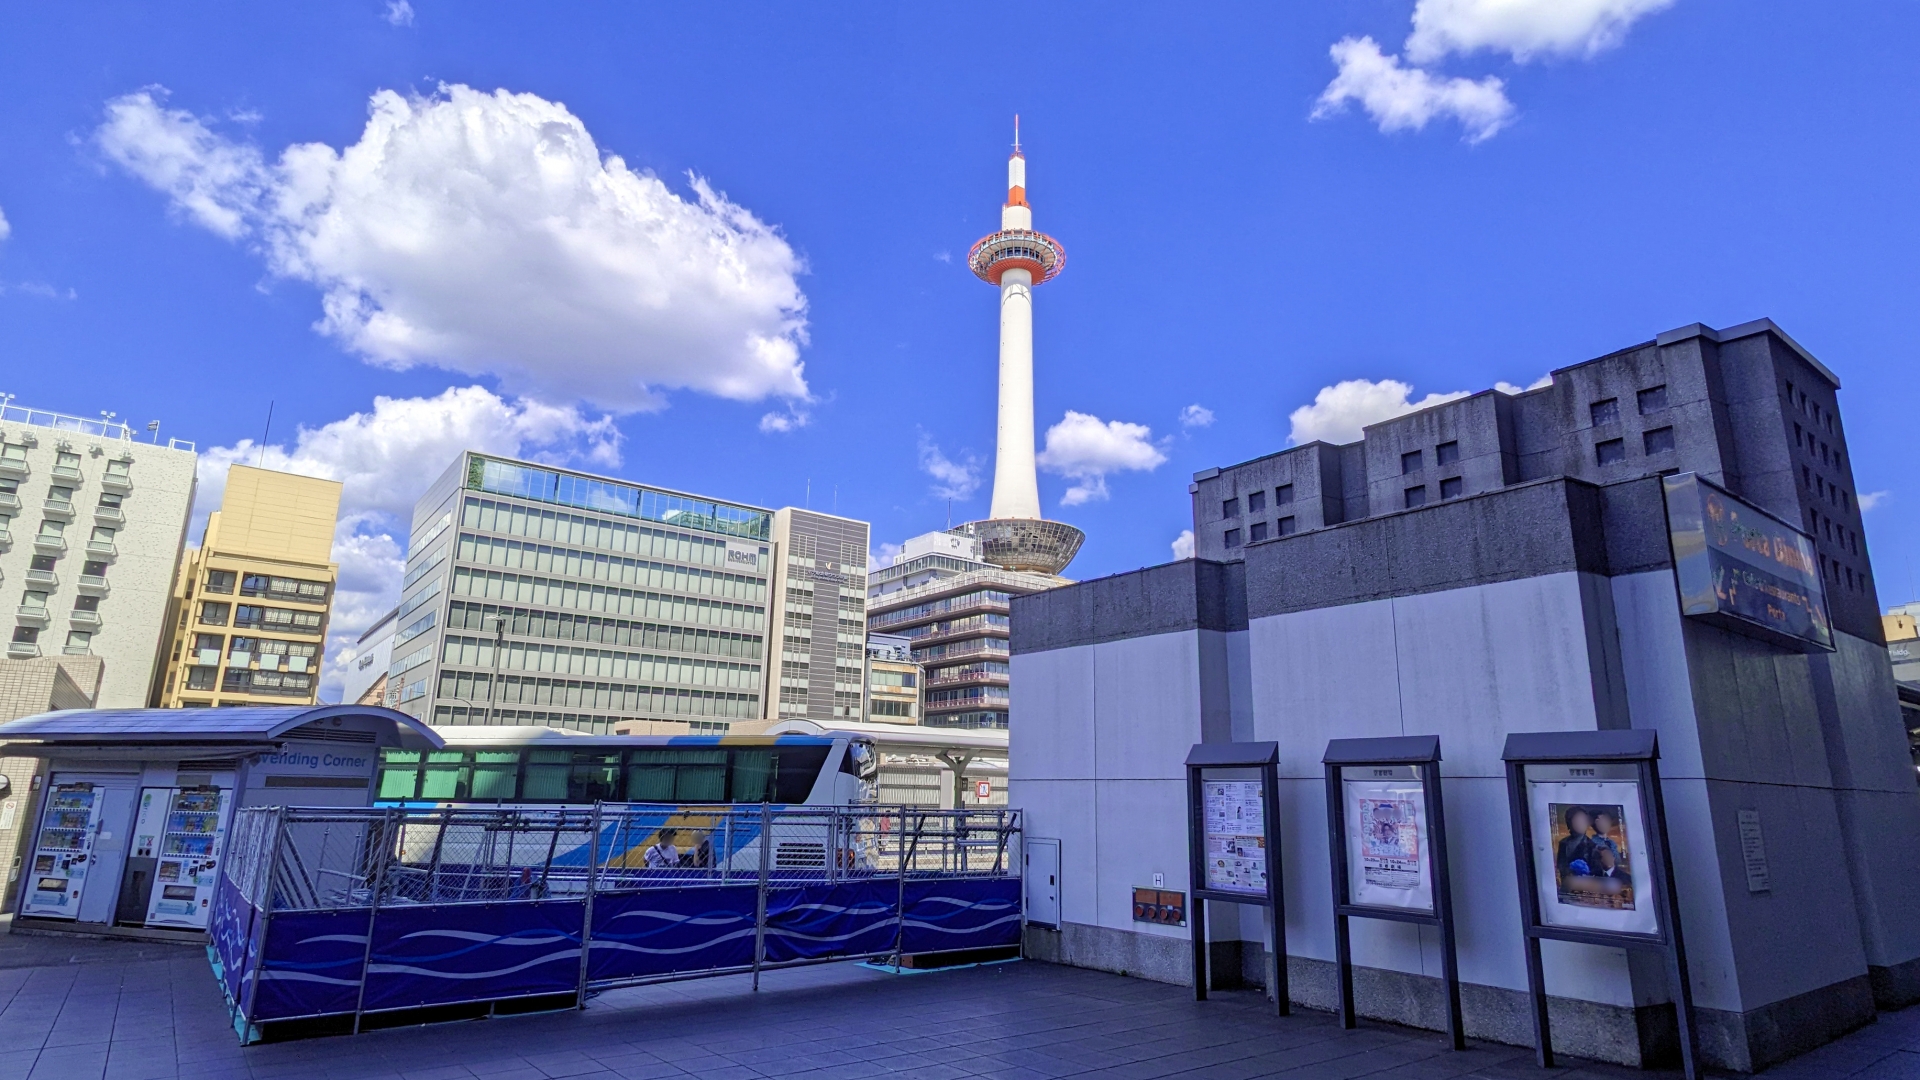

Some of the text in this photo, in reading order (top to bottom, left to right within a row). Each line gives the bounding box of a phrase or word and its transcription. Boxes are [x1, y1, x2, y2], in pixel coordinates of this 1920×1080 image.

[728, 549, 757, 564] ROHM
[259, 752, 367, 769] Vending Corner
[1155, 874, 1162, 886] H
